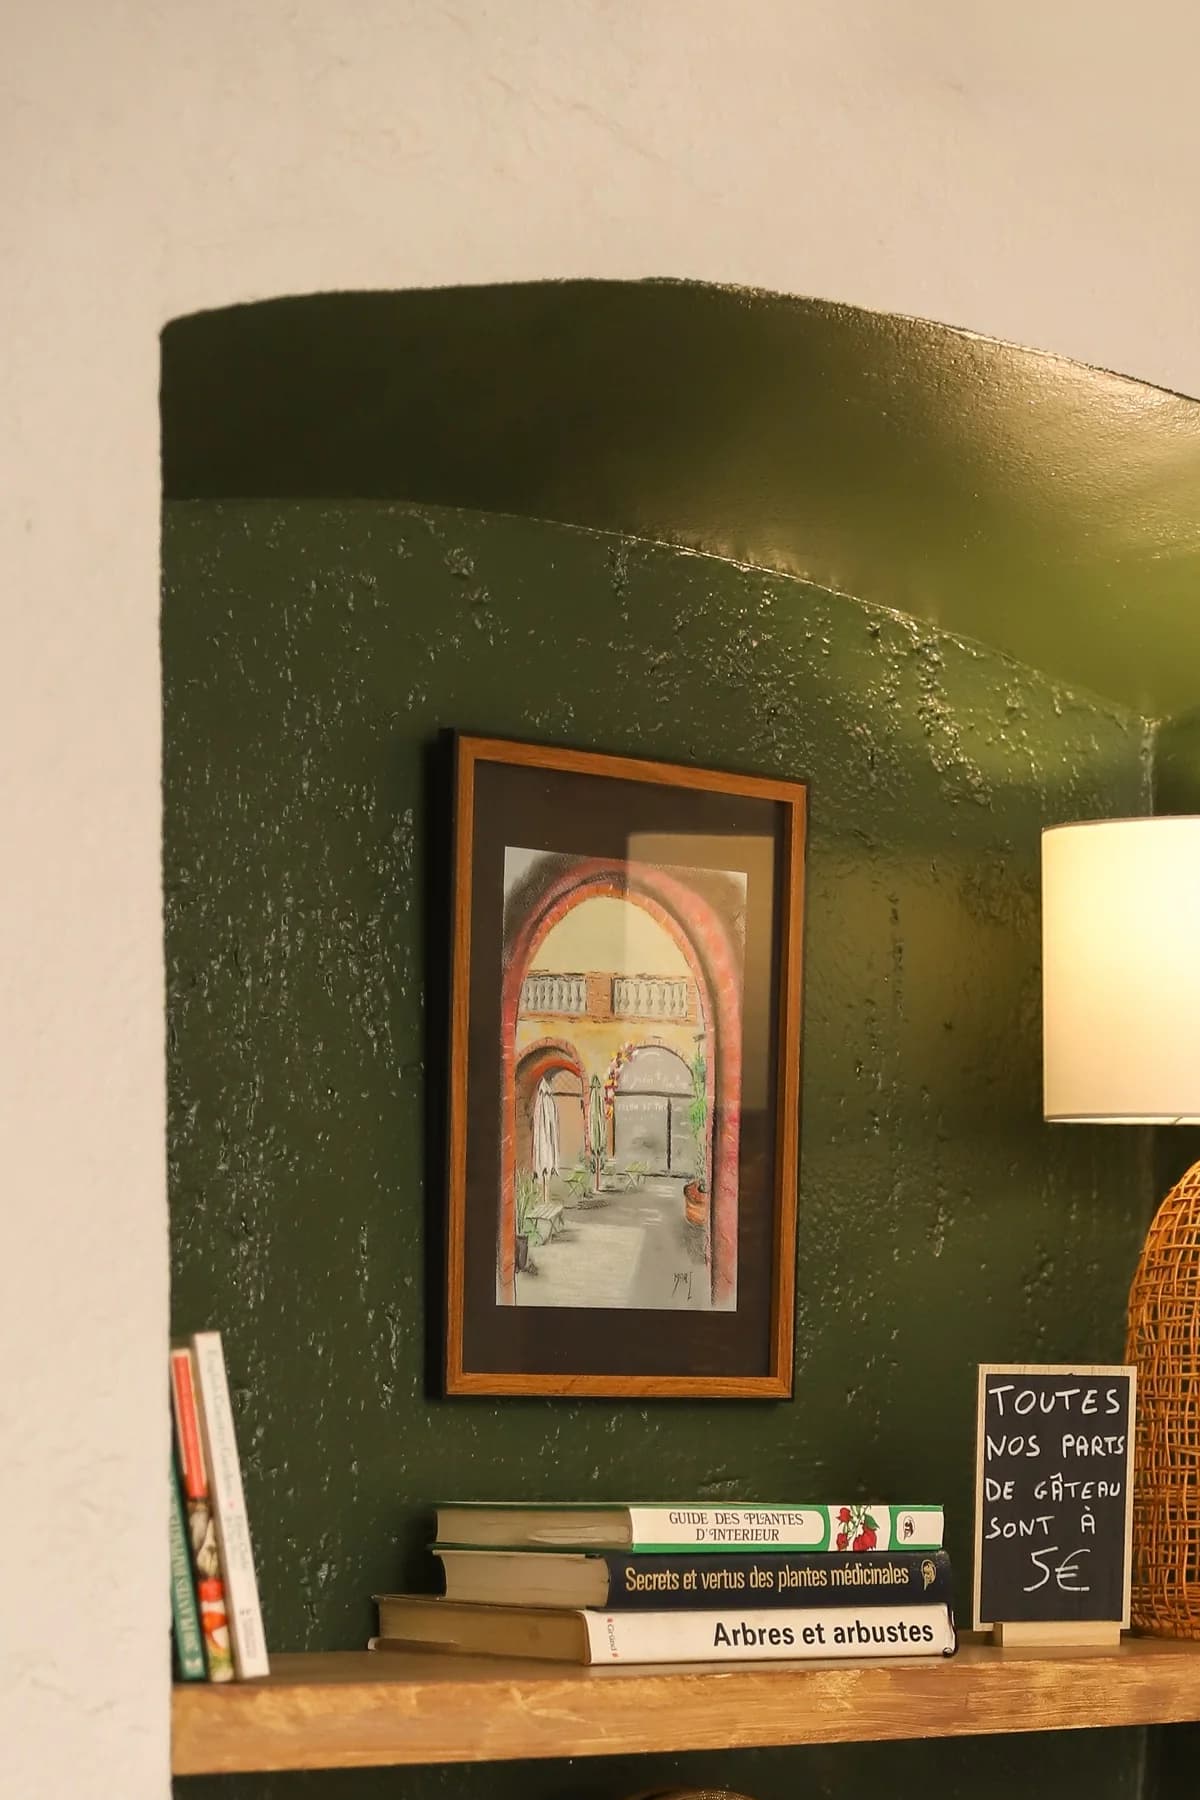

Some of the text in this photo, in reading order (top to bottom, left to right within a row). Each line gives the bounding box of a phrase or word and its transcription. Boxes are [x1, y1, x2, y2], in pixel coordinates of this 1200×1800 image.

[988, 1385, 1121, 1416] TOUTES
[986, 1433, 1126, 1461] NOS PARTS
[985, 1472, 1121, 1502] DE GÂTEAU
[669, 1512, 804, 1526] GUIDE DES PLANTES
[985, 1505, 1096, 1539] SONT À
[695, 1528, 780, 1542] D'INTERIEUR
[625, 1561, 910, 1593] Secrets et vertus des plantes médicinales
[1023, 1546, 1091, 1592] 5€
[713, 1620, 934, 1647] Arbres et arbustes
